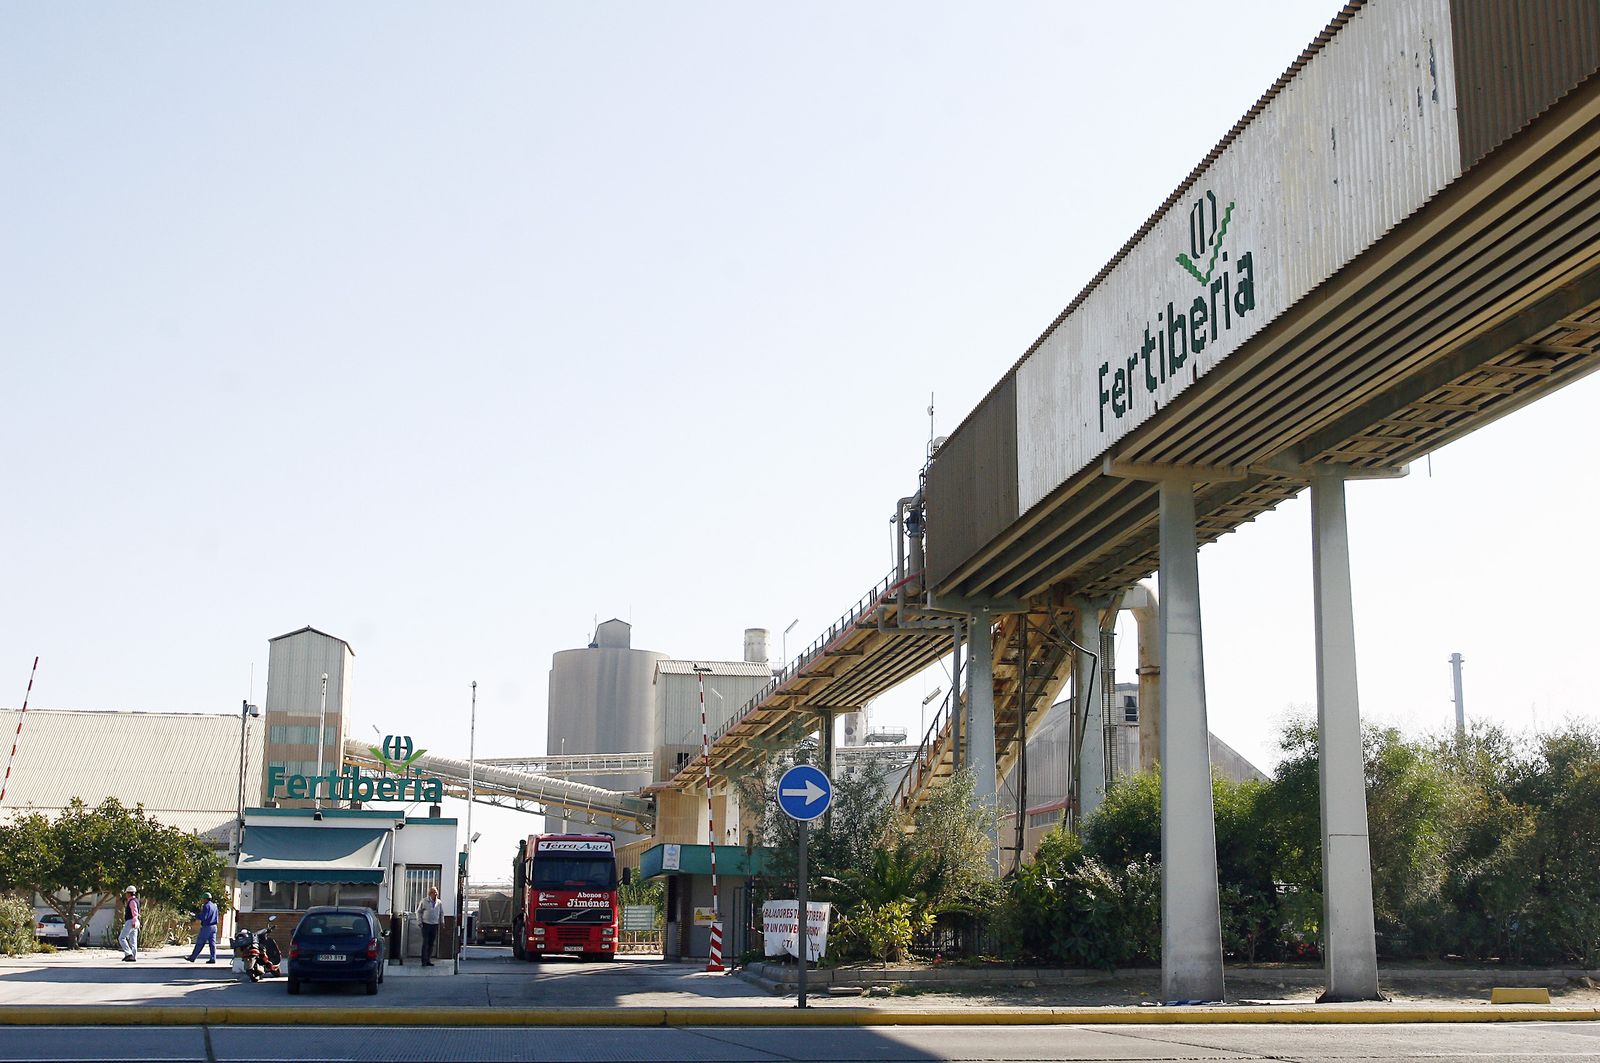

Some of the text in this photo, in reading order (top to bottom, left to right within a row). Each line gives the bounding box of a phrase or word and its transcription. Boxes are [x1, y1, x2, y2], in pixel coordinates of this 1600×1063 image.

[1099, 251, 1255, 432] Fertiberia
[268, 766, 442, 802] Fertiberia
[576, 842, 608, 850] Agri
[567, 899, 609, 907] Jiménez
